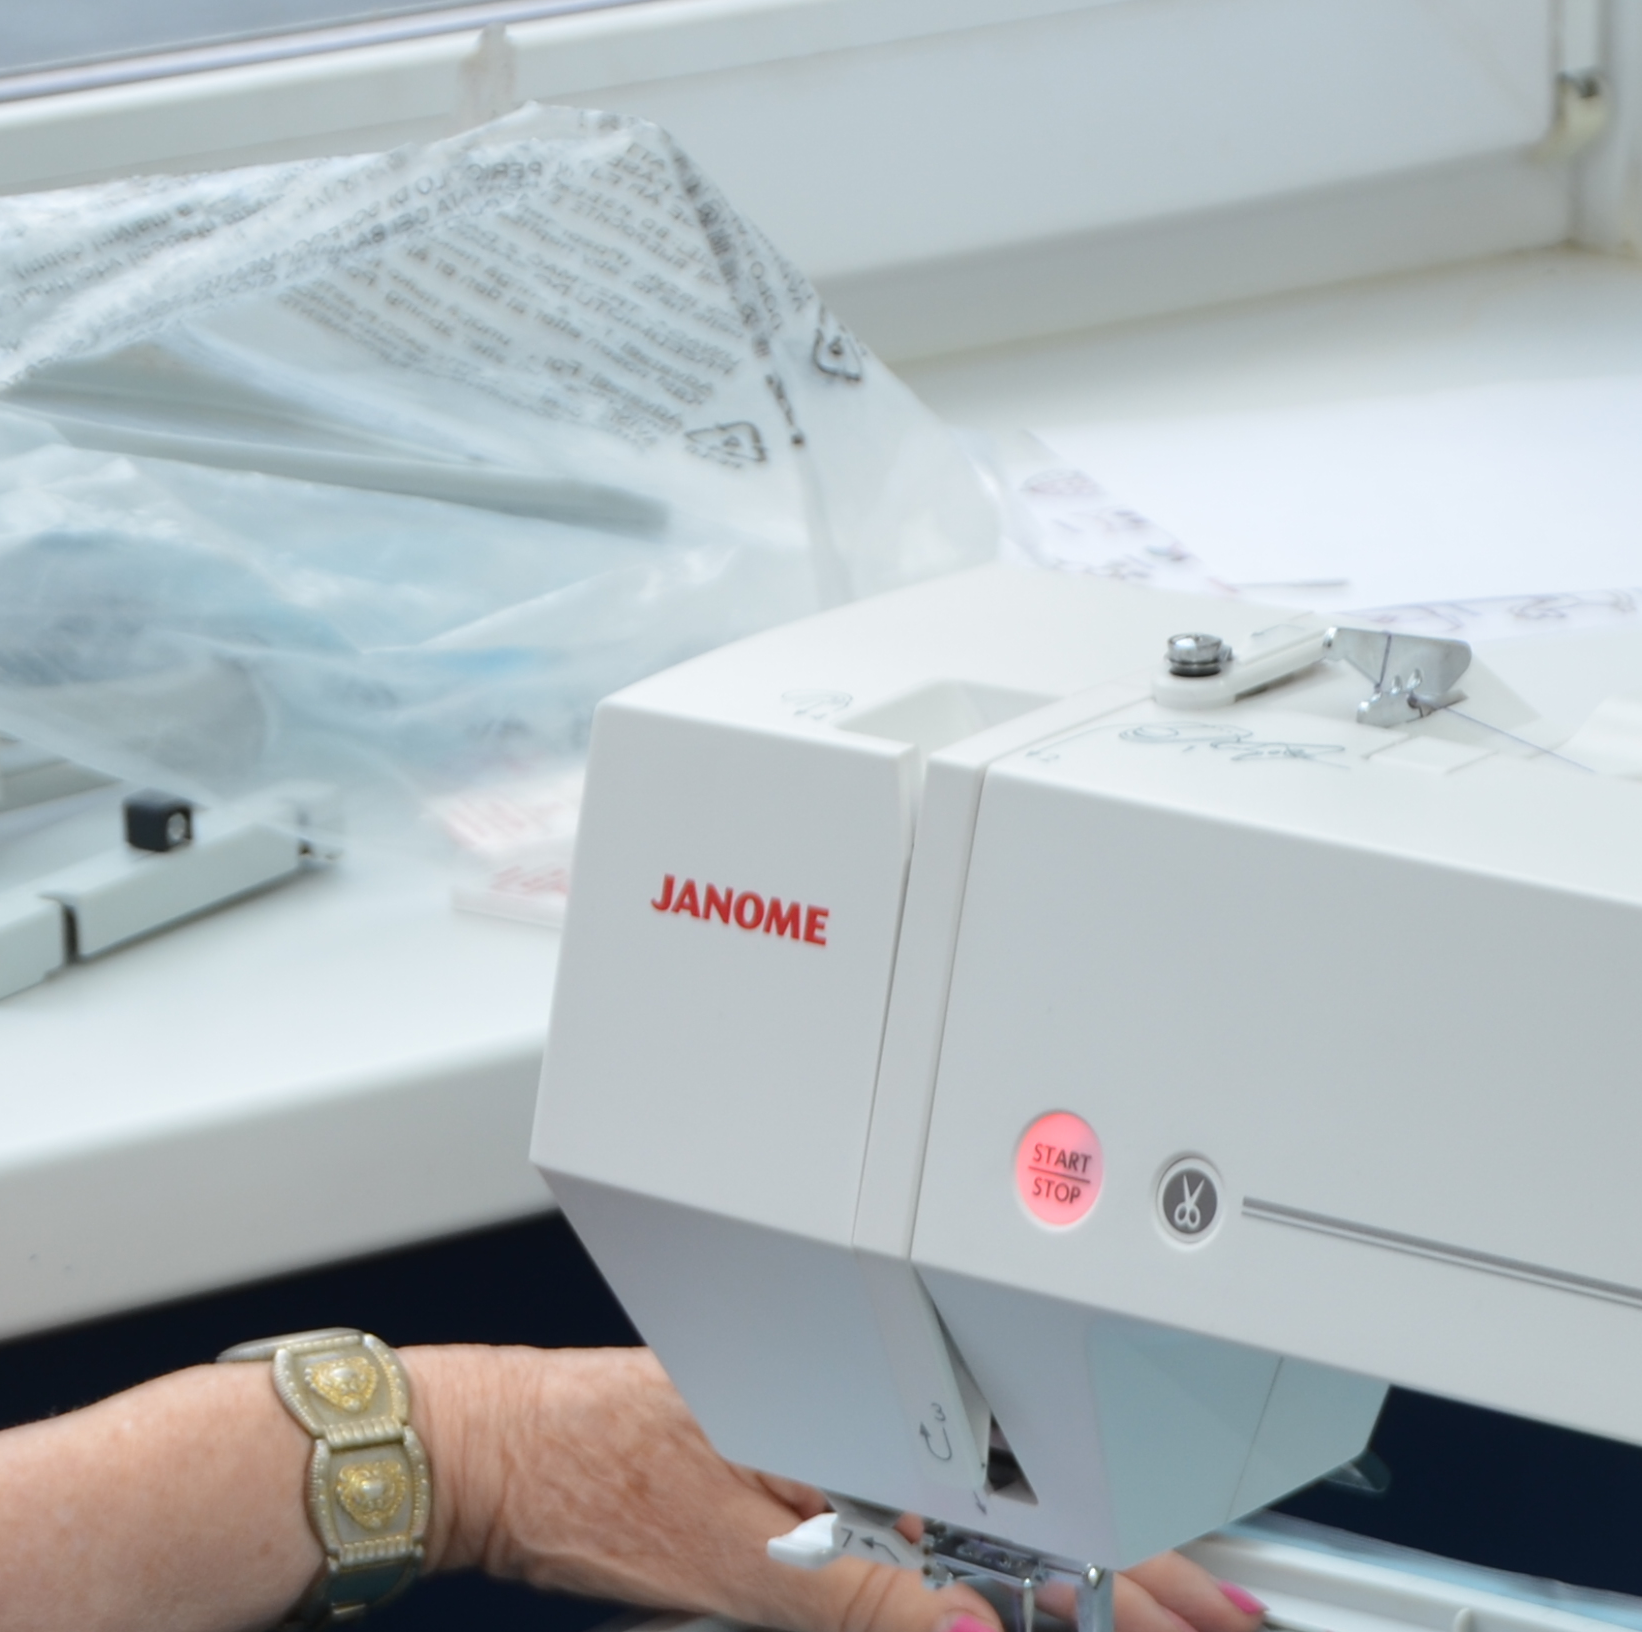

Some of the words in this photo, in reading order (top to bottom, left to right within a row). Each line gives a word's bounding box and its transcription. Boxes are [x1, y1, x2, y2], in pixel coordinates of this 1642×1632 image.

[650, 873, 830, 947] JANOME
[1033, 1142, 1093, 1174] START
[1032, 1177, 1082, 1205] STOP
[930, 1402, 947, 1422] 3
